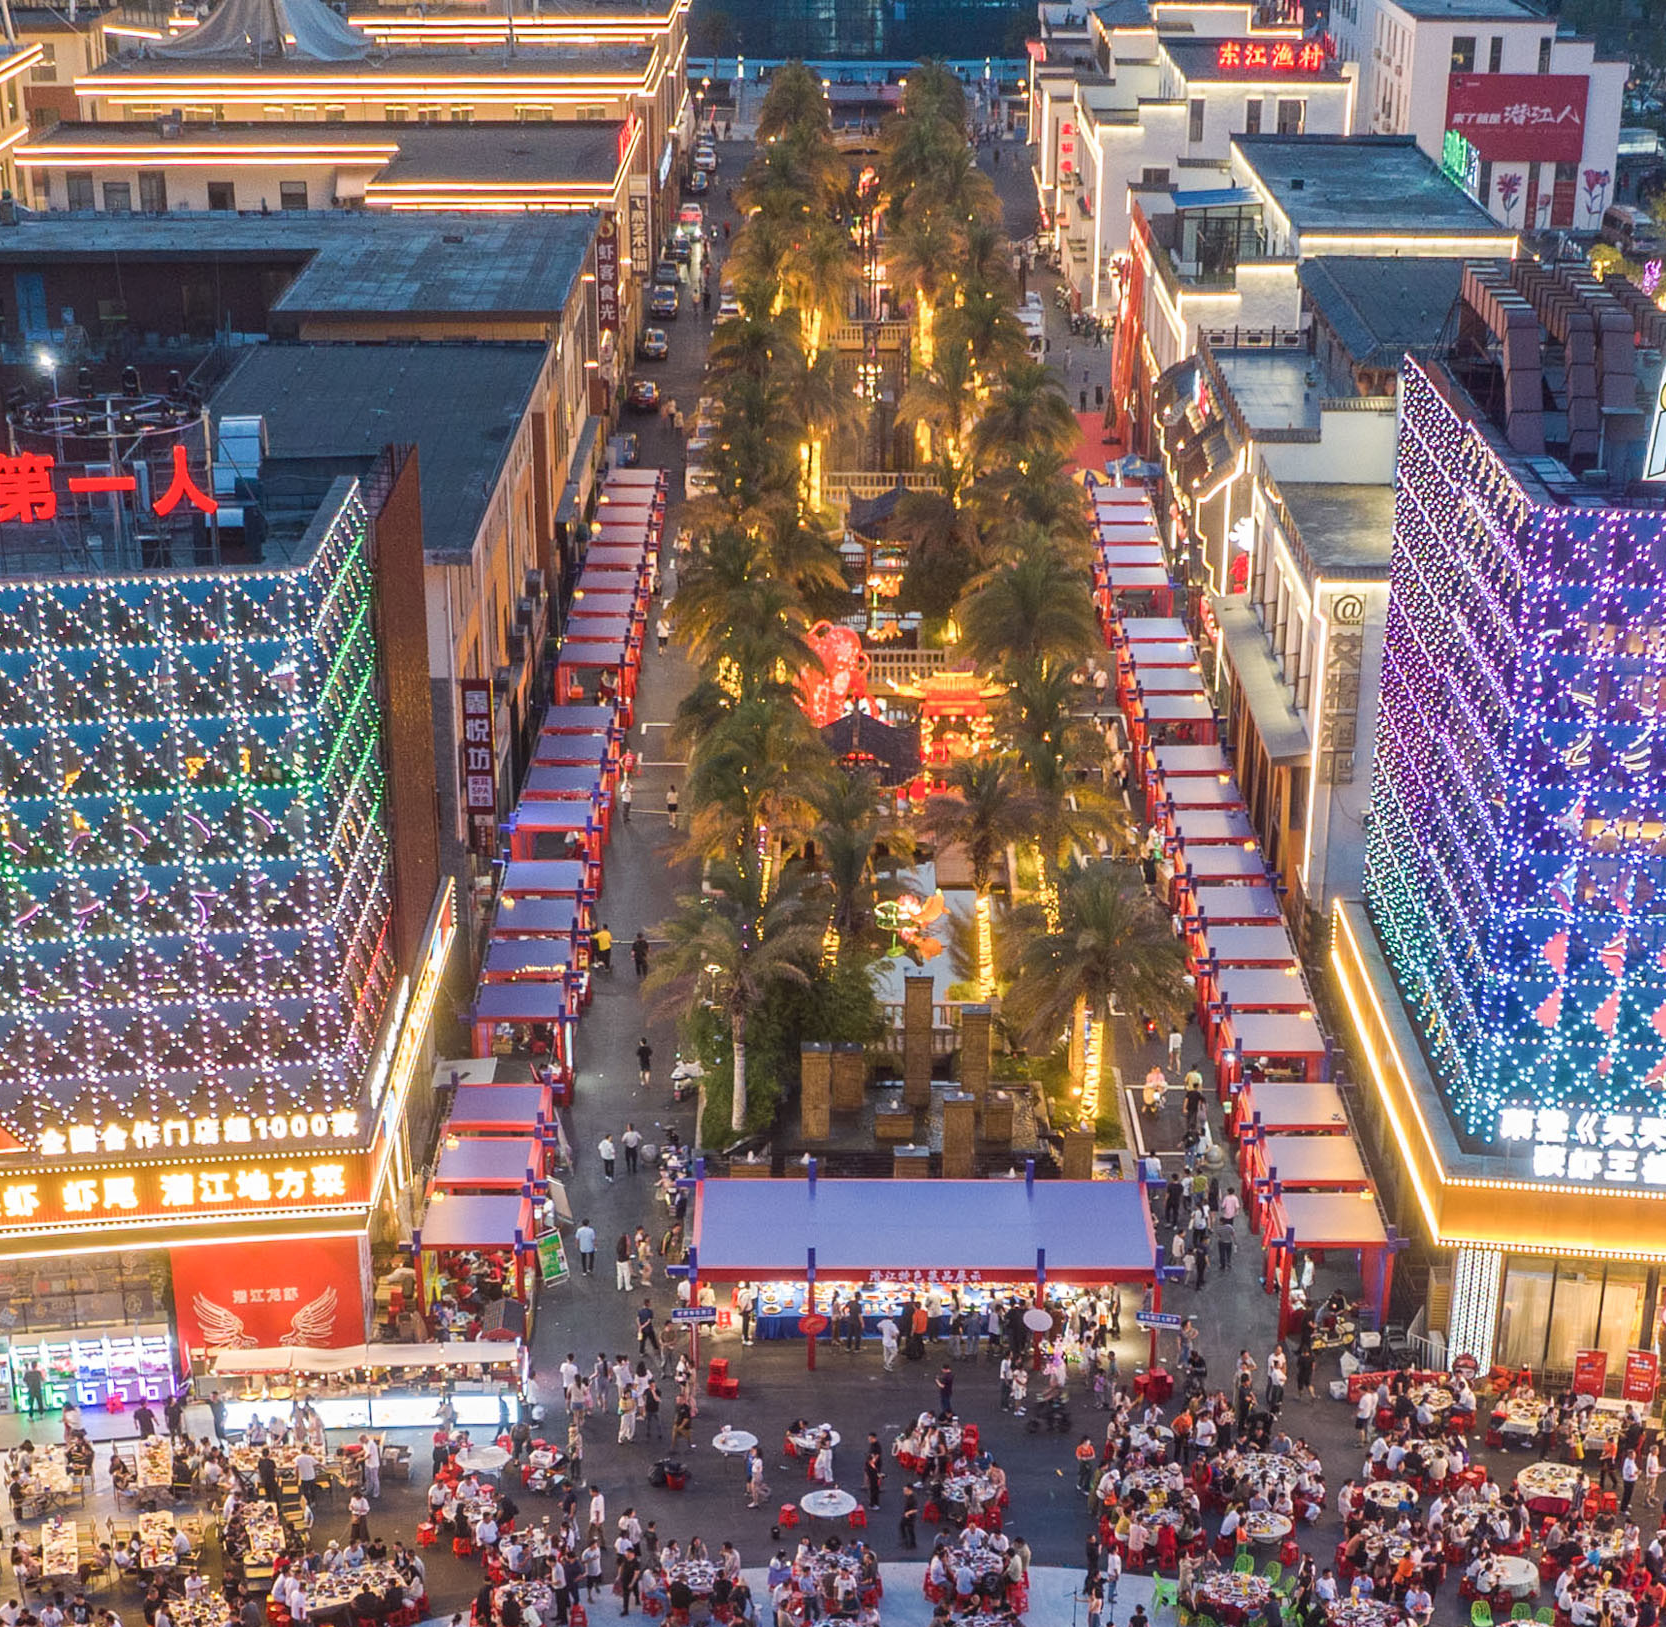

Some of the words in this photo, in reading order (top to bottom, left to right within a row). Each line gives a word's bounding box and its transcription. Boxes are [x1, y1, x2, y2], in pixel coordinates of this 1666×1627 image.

[1219, 41, 1325, 70] 东江渔村
[598, 244, 616, 321] 虾客食光
[37, 1110, 359, 1156] 全国合作门店超1000家
[62, 1176, 139, 1213] 虾尾
[160, 1164, 347, 1207] 潜江地方菜
